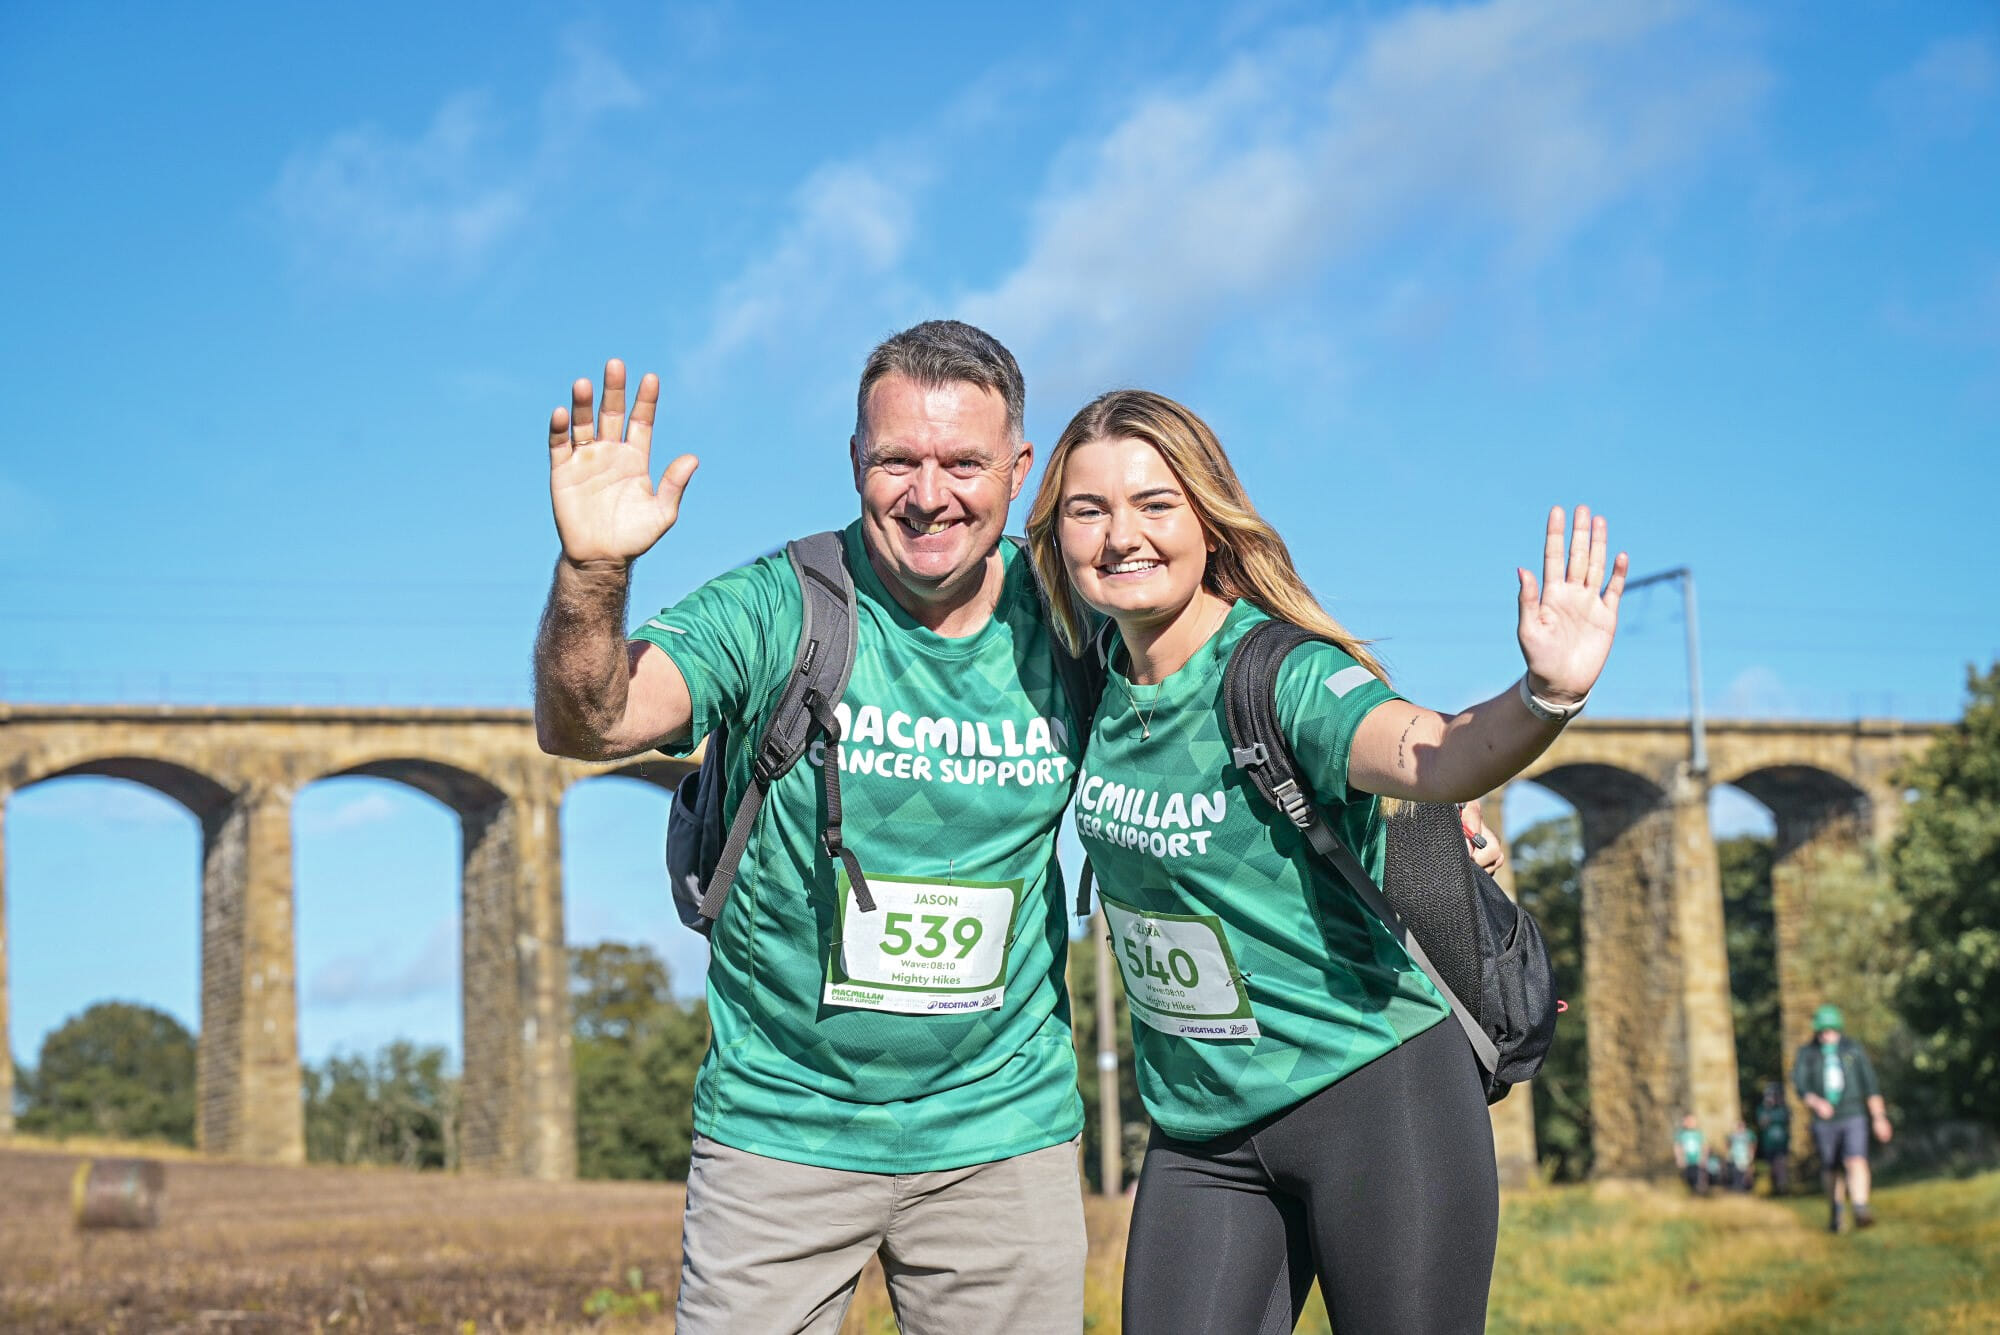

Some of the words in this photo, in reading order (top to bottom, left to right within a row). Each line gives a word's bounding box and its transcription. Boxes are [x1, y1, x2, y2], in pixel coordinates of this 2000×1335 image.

[939, 756, 1068, 787] SUPPORT
[1076, 768, 1226, 829] CMILLAN
[1105, 821, 1212, 858] SUPPORT
[914, 893, 958, 907] JASON
[879, 911, 983, 959] 539
[901, 959, 956, 970] Wave:08:10
[1123, 936, 1199, 988] 540
[891, 972, 930, 985] Mighty
[932, 975, 961, 985] Hikes
[831, 988, 884, 1001] MACMILLAN
[938, 1001, 979, 1009] DECATHLON
[1172, 1002, 1196, 1011] Hikes
[1187, 1026, 1226, 1034] DECATHLON
